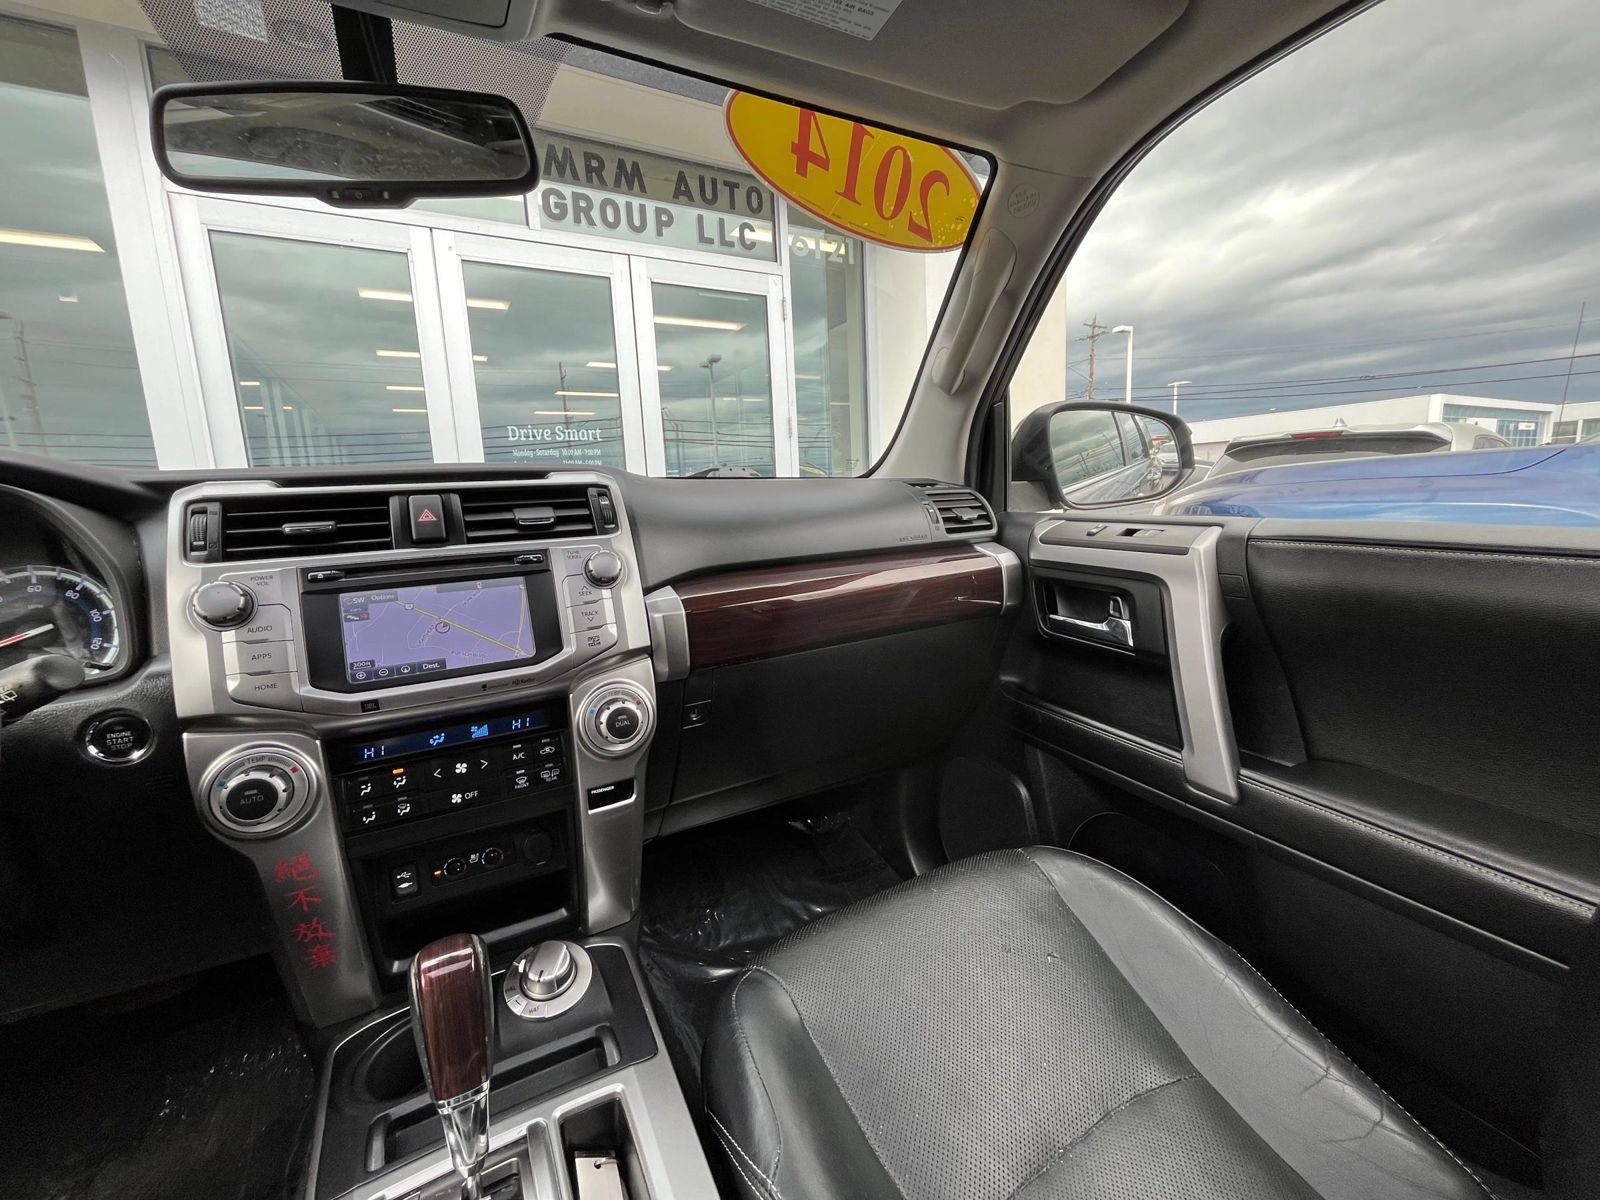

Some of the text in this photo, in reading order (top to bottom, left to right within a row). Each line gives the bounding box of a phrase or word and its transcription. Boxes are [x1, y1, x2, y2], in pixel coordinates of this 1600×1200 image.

[543, 143, 763, 214] MRM AUTO
[541, 187, 757, 250] GROUP LLC
[507, 425, 603, 441] Drive Smart
[26, 585, 42, 593] 60
[65, 589, 80, 600] 80
[89, 608, 103, 623] 100
[247, 624, 273, 634] AUDIO
[90, 637, 103, 650] 120
[251, 652, 273, 662] APPS
[422, 662, 441, 670] Dest.
[254, 681, 279, 692] HOME
[615, 720, 631, 728] DUAL
[106, 731, 132, 739] ENGINE
[106, 736, 135, 746] START
[110, 742, 133, 751] STOP
[247, 756, 267, 766] TEMP
[512, 752, 526, 760] A/C
[239, 794, 265, 806] AUTO
[464, 790, 479, 800] OFF
